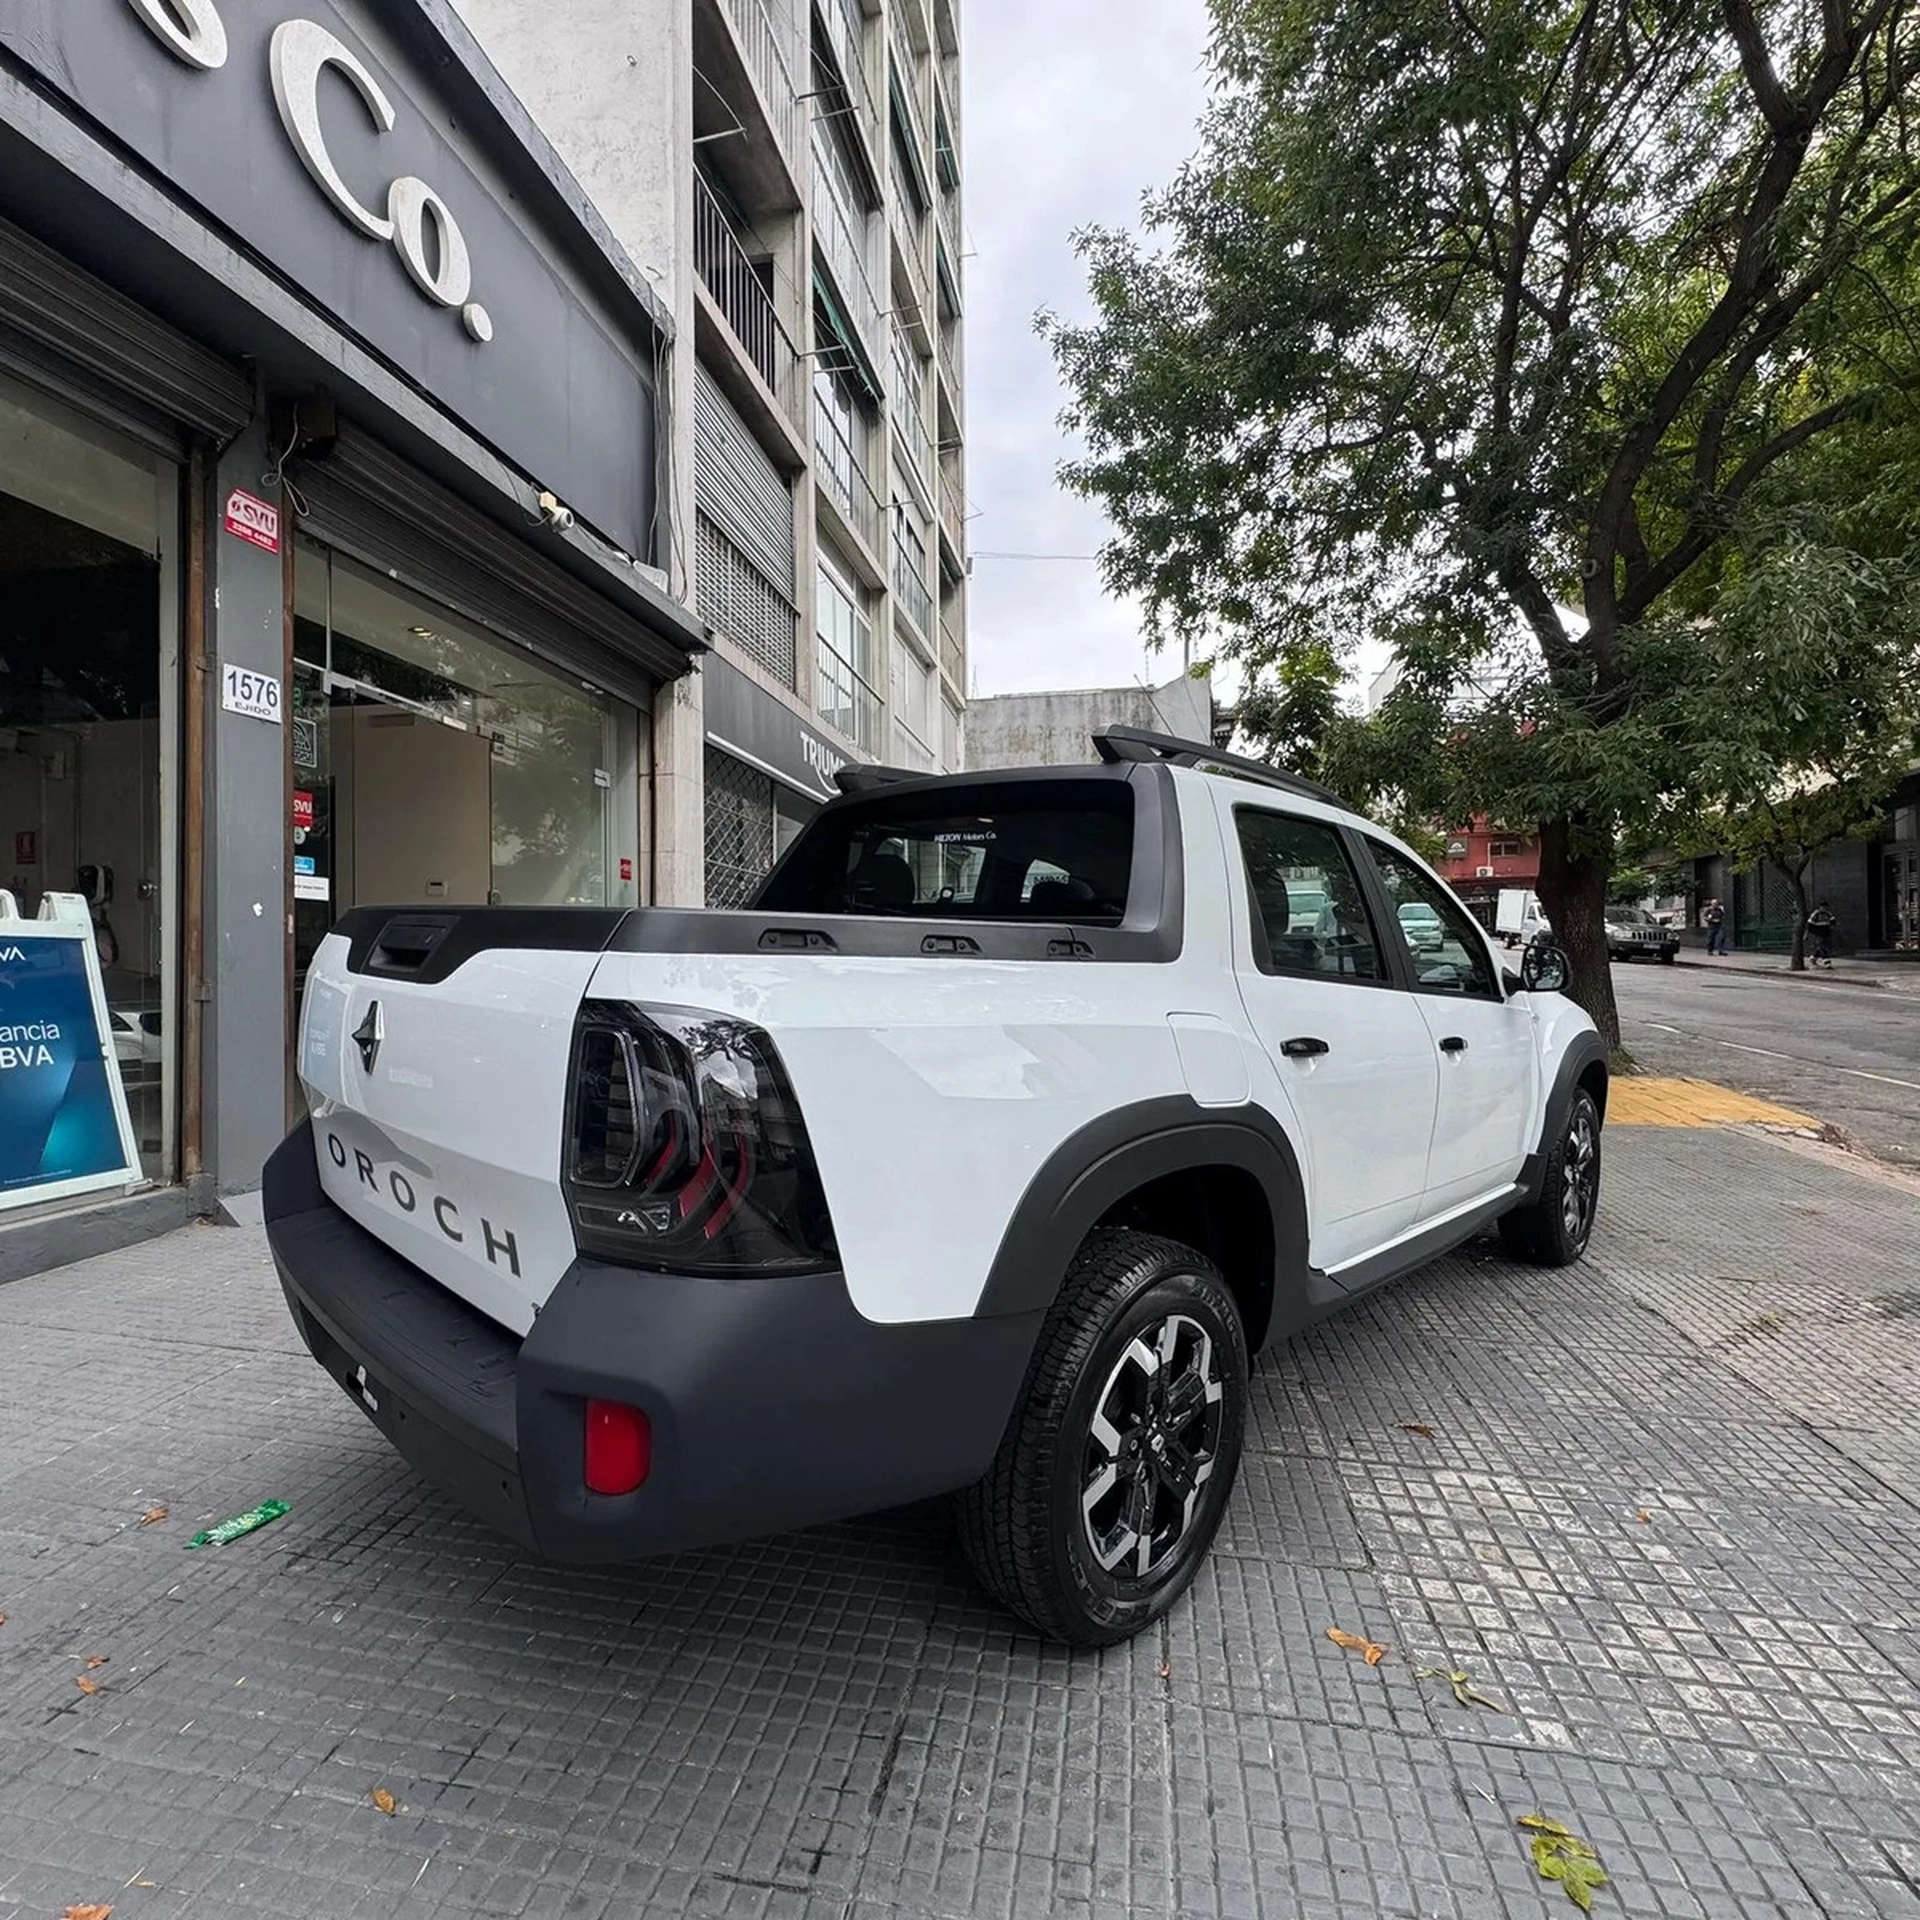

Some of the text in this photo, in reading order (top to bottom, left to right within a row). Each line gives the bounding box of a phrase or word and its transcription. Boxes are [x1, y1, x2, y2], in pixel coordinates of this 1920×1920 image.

[269, 18, 494, 344] Co.
[243, 503, 275, 533] SVU
[228, 670, 278, 708] 1576
[234, 701, 271, 716] EJIDO
[0, 1044, 55, 1069] BVA
[328, 1132, 521, 1279] OROCH
